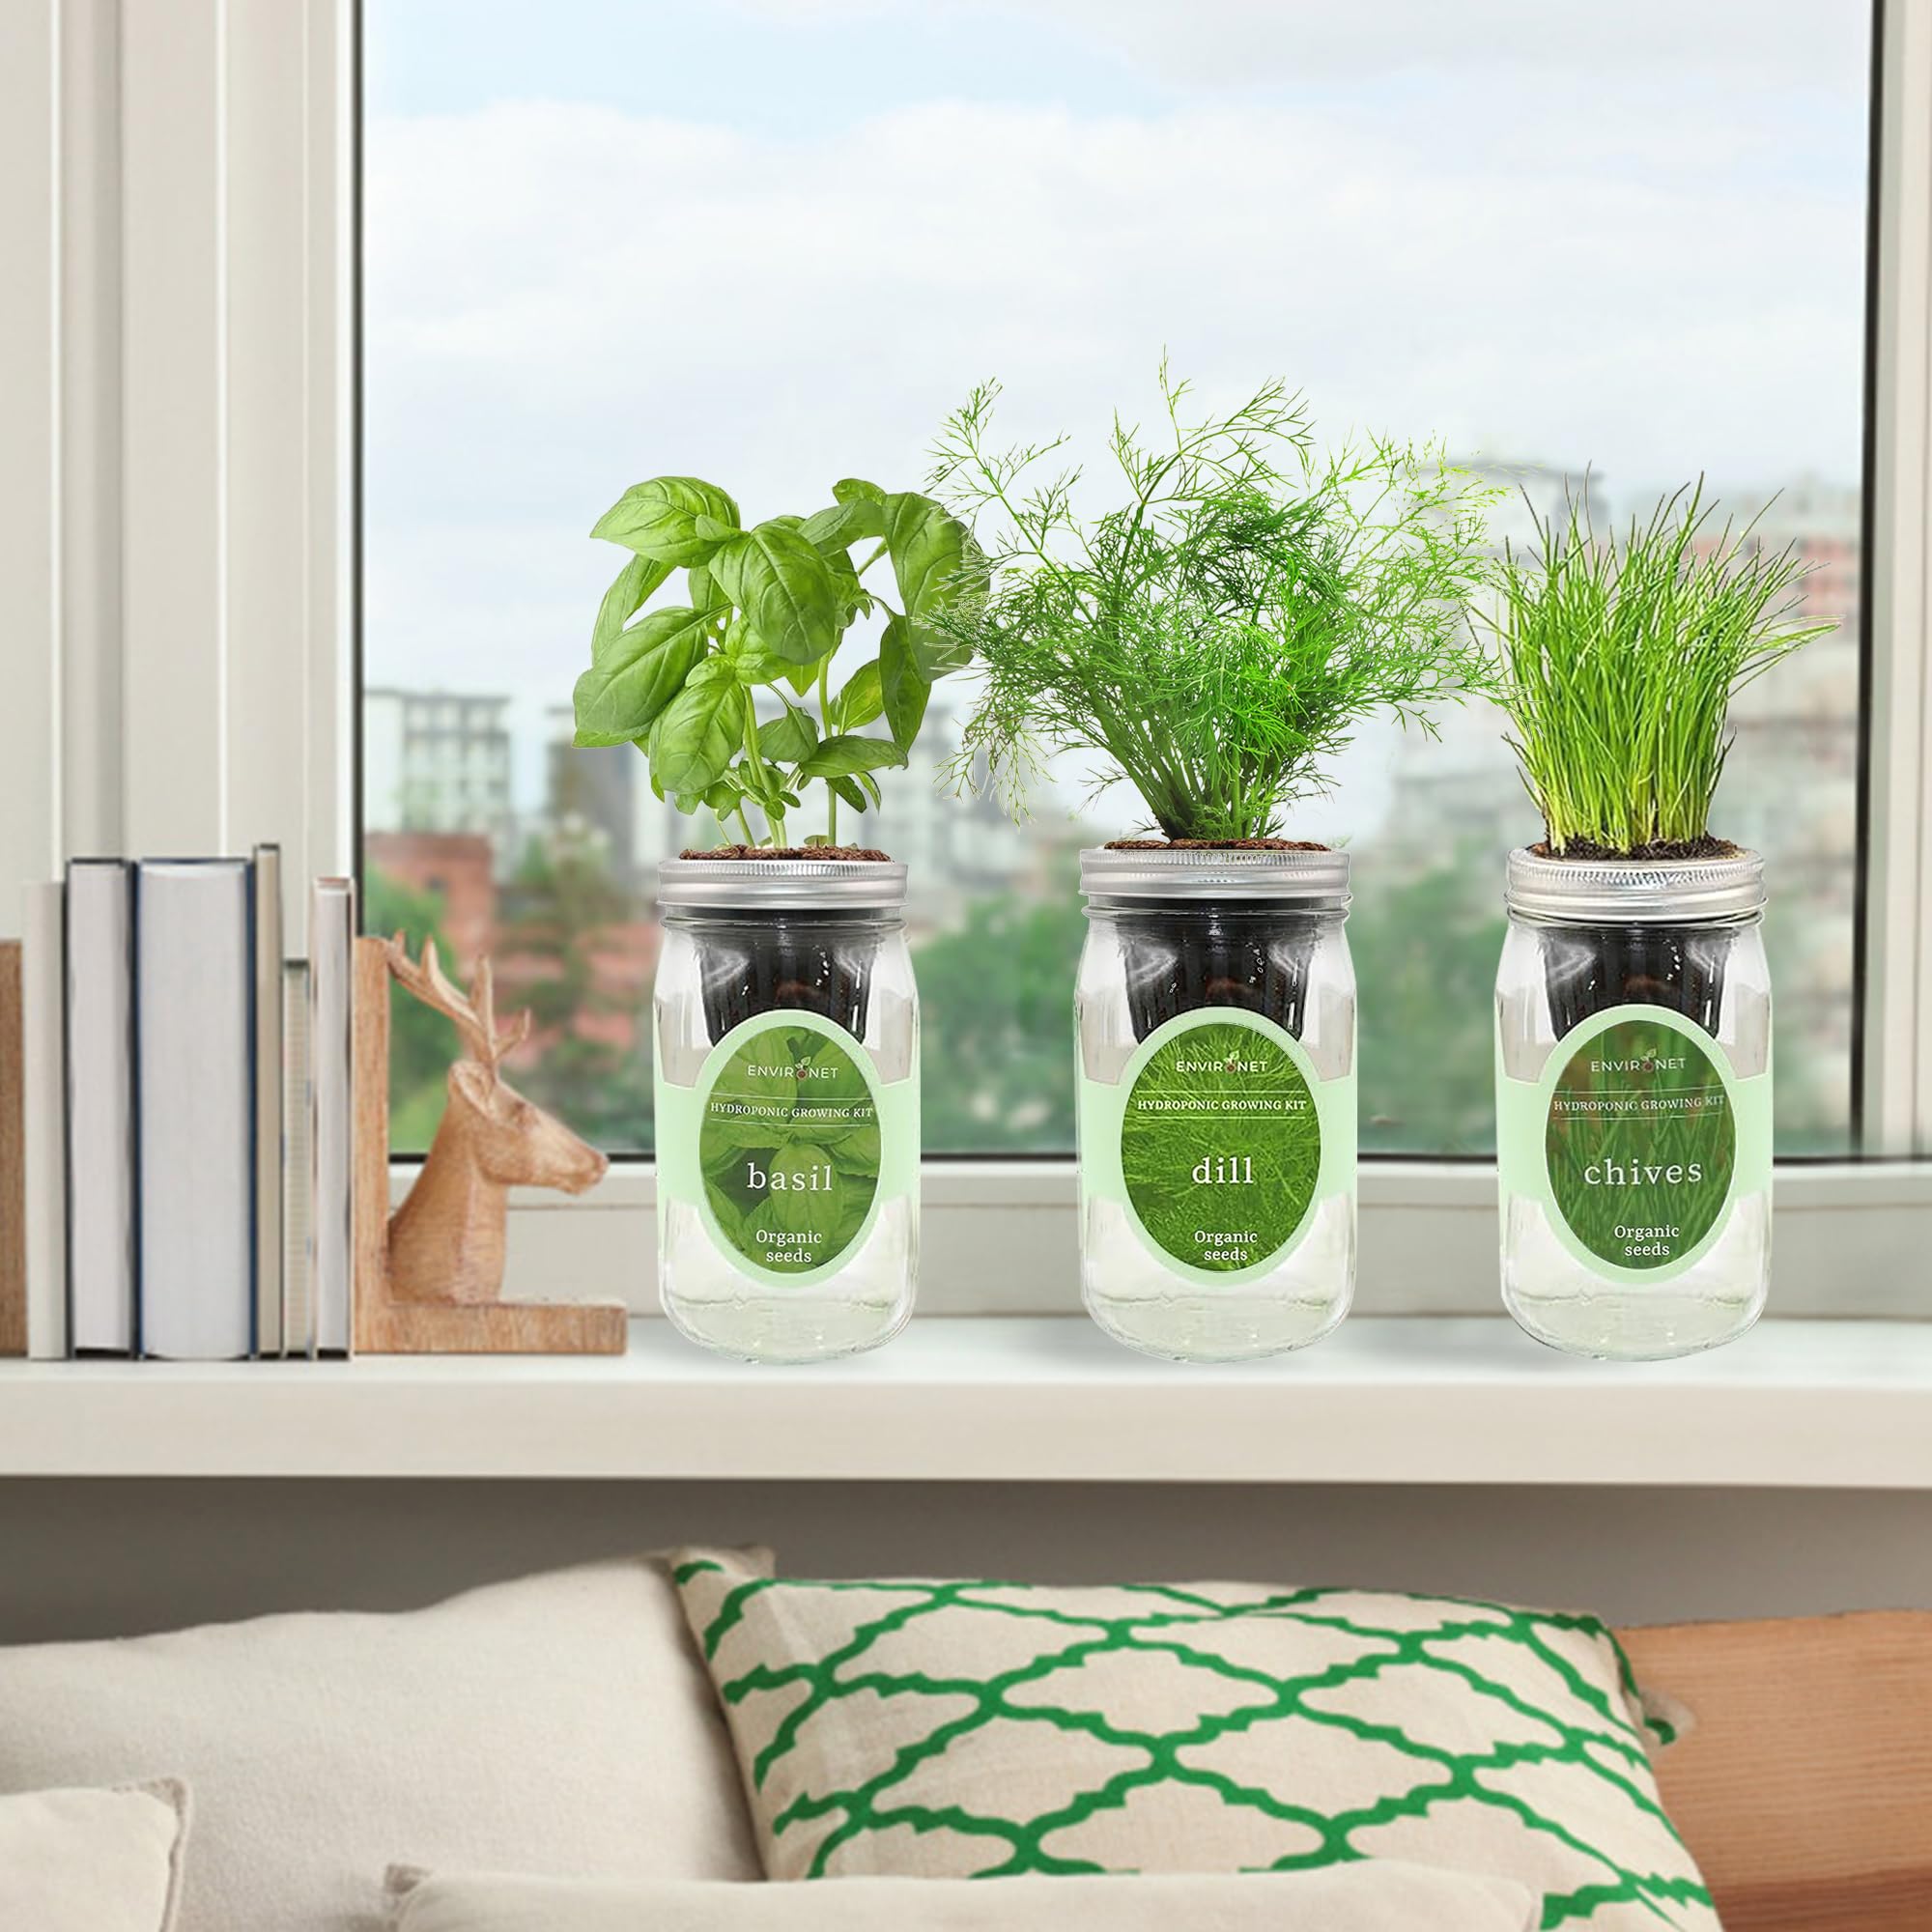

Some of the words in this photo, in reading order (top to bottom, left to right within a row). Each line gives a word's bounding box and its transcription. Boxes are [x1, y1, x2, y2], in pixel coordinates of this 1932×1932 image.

[710, 1102, 788, 1118] HYDROPONIC
[791, 1107, 850, 1118] GROWING
[853, 1107, 873, 1118] KIT
[1137, 1100, 1219, 1111] HYDROPONIC
[1221, 1100, 1282, 1111] GROWING
[1285, 1100, 1307, 1111] KIT
[1553, 1100, 1638, 1111] HYDROPONIC
[1640, 1097, 1702, 1110] GROWING
[1705, 1095, 1724, 1106] KIT
[747, 1162, 833, 1191] basil
[1191, 1156, 1255, 1184] dill
[1584, 1158, 1703, 1185] chives
[755, 1230, 822, 1247] Organic
[1194, 1230, 1258, 1247] Organic
[1614, 1224, 1680, 1242] Organic
[766, 1248, 812, 1263] seeds
[1204, 1247, 1248, 1261] seeds
[1625, 1241, 1670, 1257] seeds
